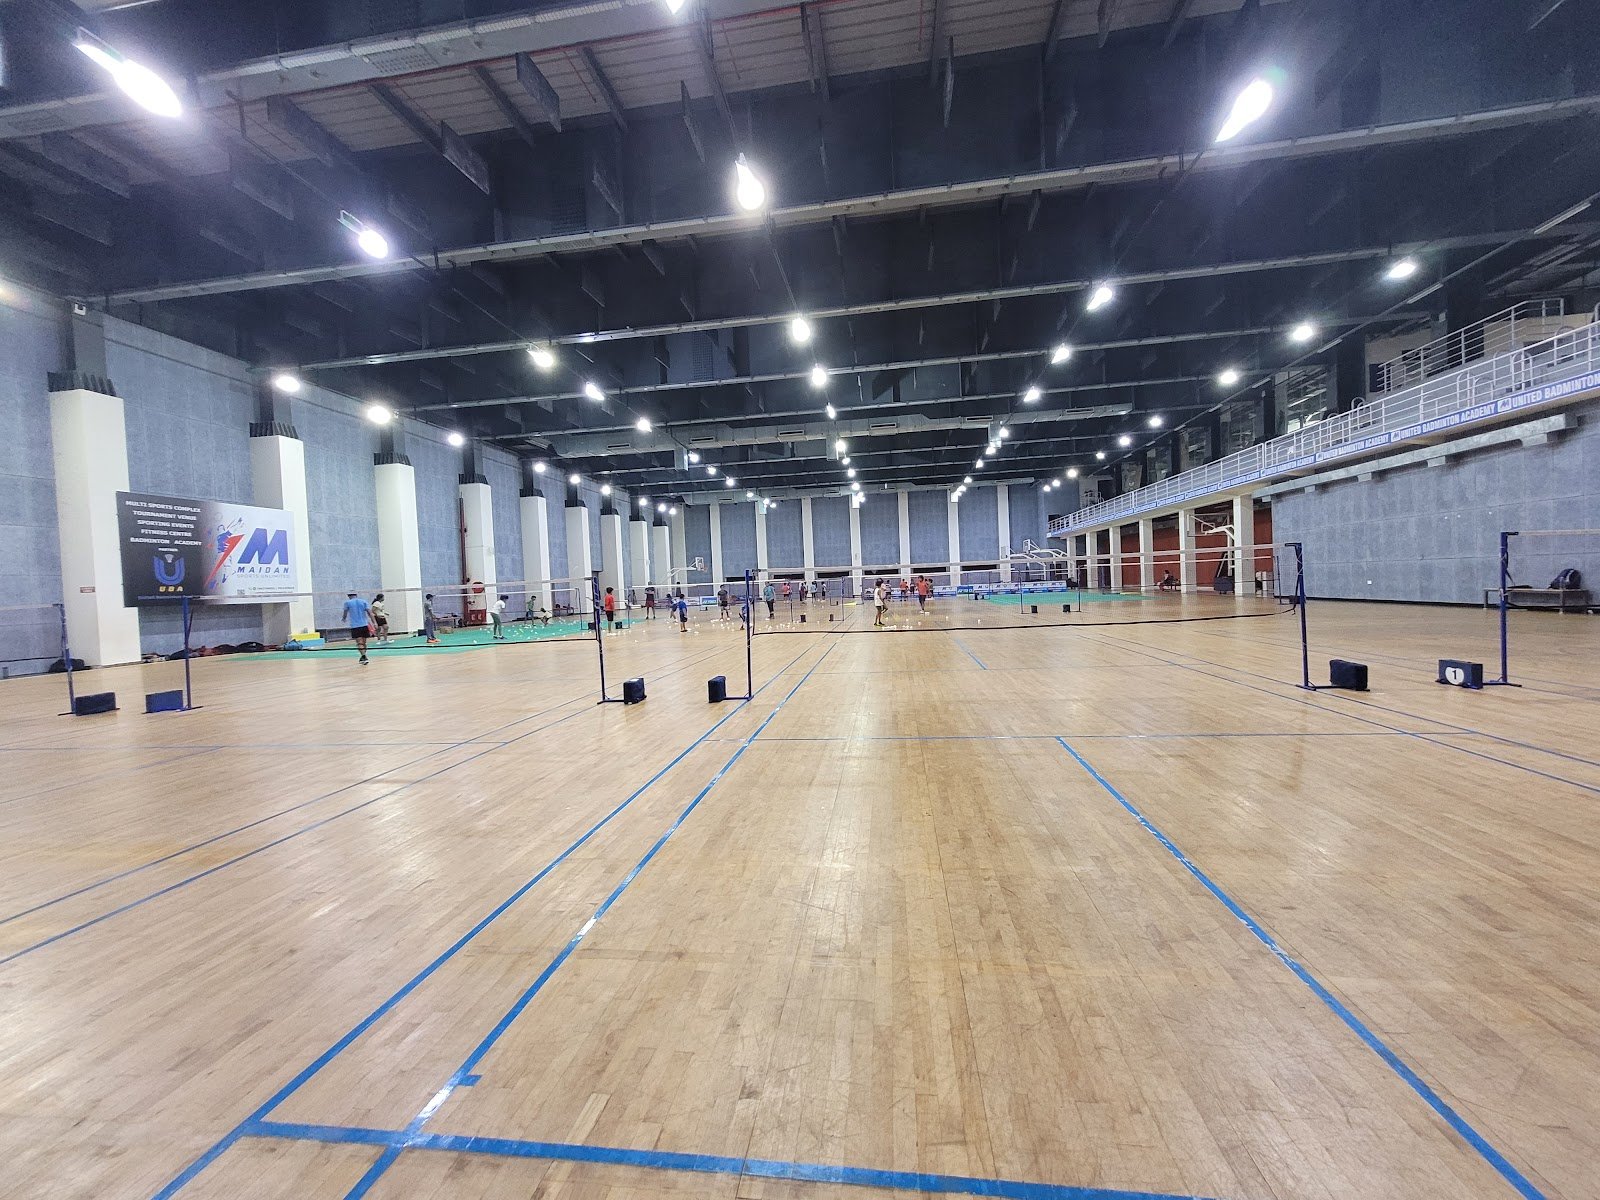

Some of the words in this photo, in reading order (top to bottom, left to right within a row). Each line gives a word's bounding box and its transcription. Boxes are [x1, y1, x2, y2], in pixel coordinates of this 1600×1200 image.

[1512, 390, 1542, 408] UNITED
[1544, 372, 1600, 398] BADMINTON
[1400, 424, 1422, 438] UNITED
[1422, 413, 1460, 432] BADMINTON
[1460, 403, 1496, 422] ACADEMY
[1365, 433, 1389, 448] ACADEMY
[125, 500, 147, 508] MULTI
[173, 505, 201, 513] COMPLEX
[132, 510, 176, 519] TOURNAMENT
[137, 519, 171, 527] SPORTING
[140, 528, 169, 536] FITNESS
[236, 566, 290, 574] MAIDAN
[1452, 669, 1457, 680] 1
